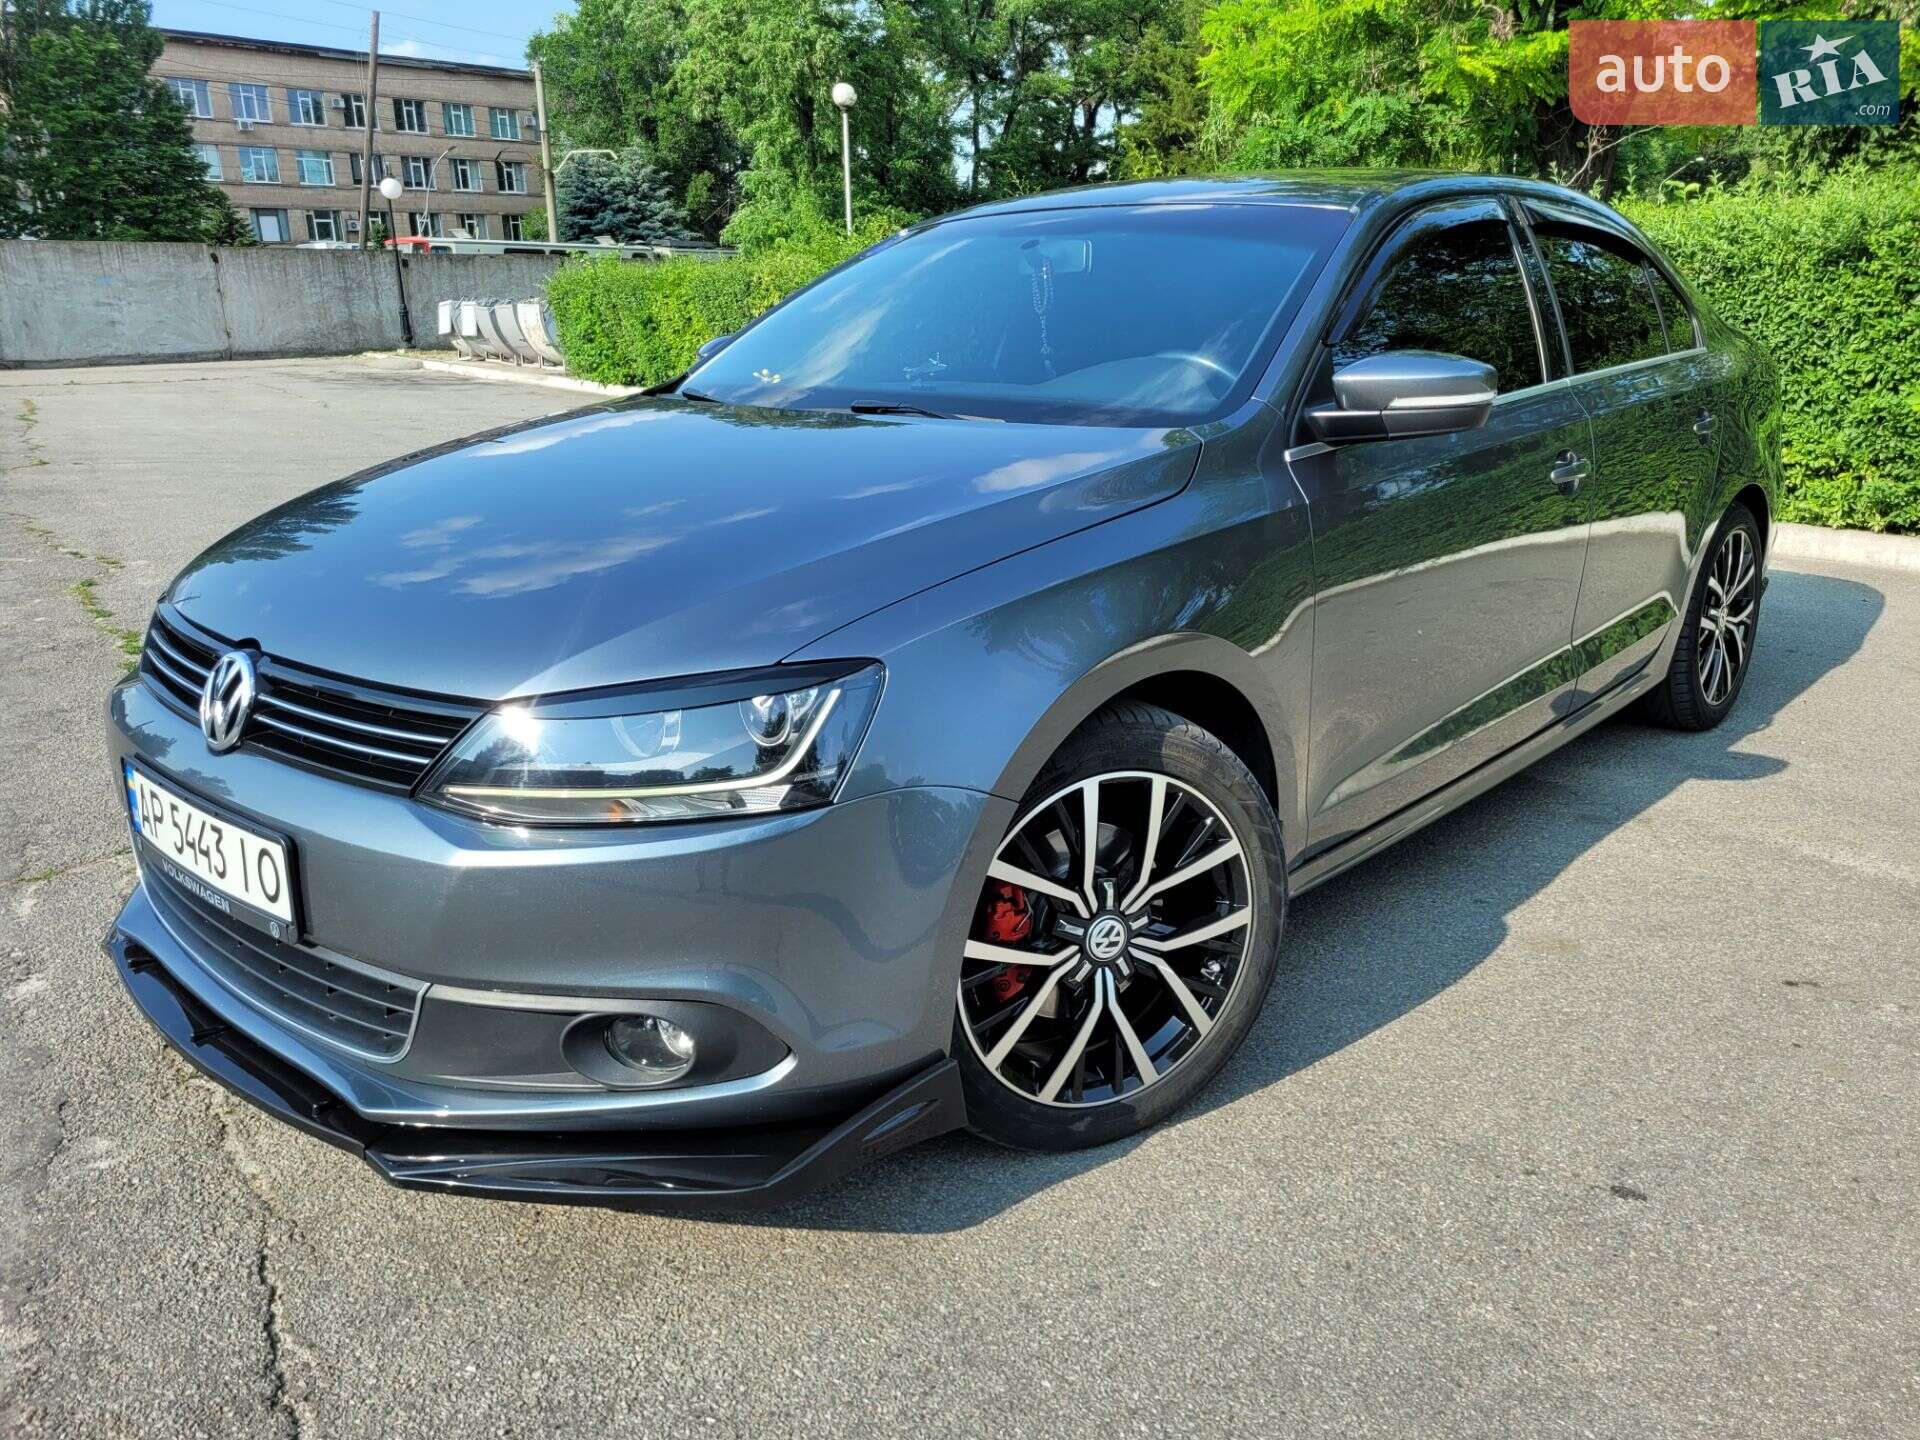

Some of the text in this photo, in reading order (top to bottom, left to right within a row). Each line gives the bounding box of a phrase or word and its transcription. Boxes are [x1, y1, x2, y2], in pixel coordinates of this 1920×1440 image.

[140, 783, 164, 839] AP
[169, 801, 228, 880] 5443
[161, 858, 231, 914] VOLKSWAGEN
